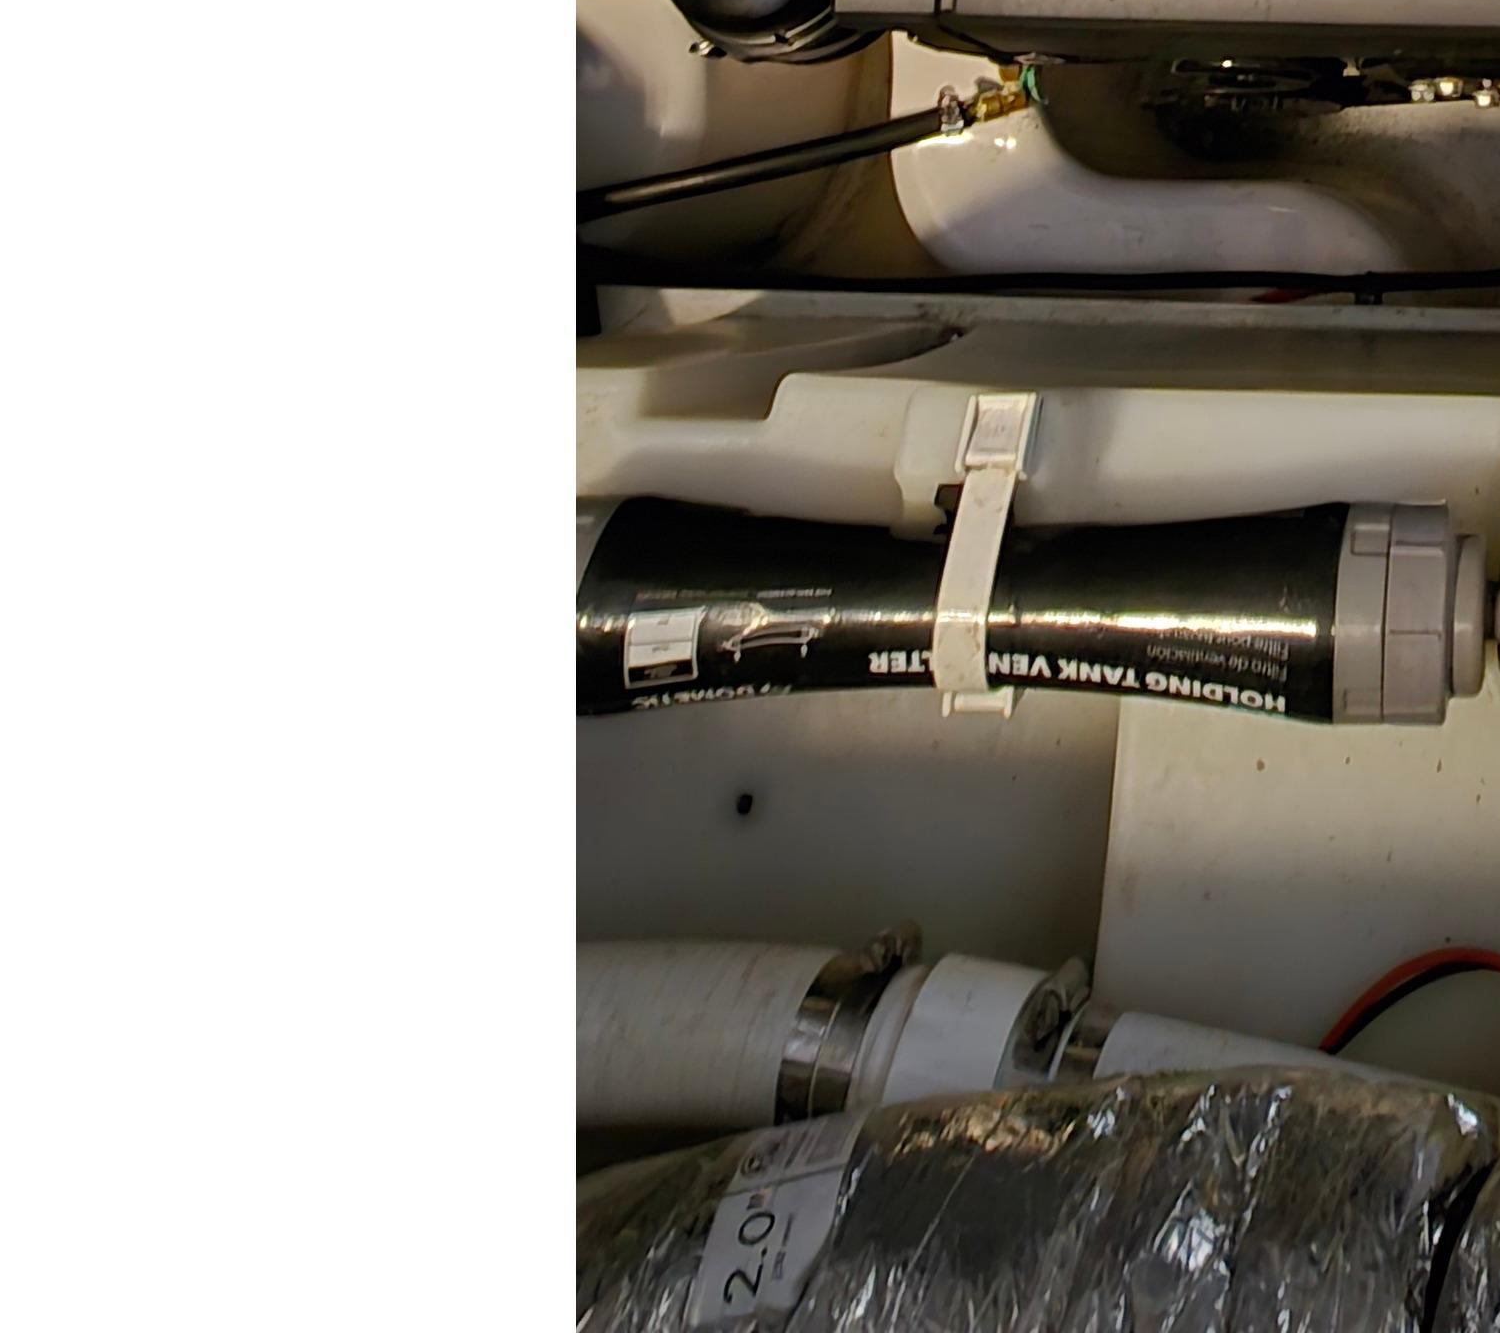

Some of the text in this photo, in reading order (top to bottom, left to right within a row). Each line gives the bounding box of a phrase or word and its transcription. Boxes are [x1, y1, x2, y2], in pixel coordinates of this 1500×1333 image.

[868, 649, 1286, 712] HOLDING TANK VEN LTER
